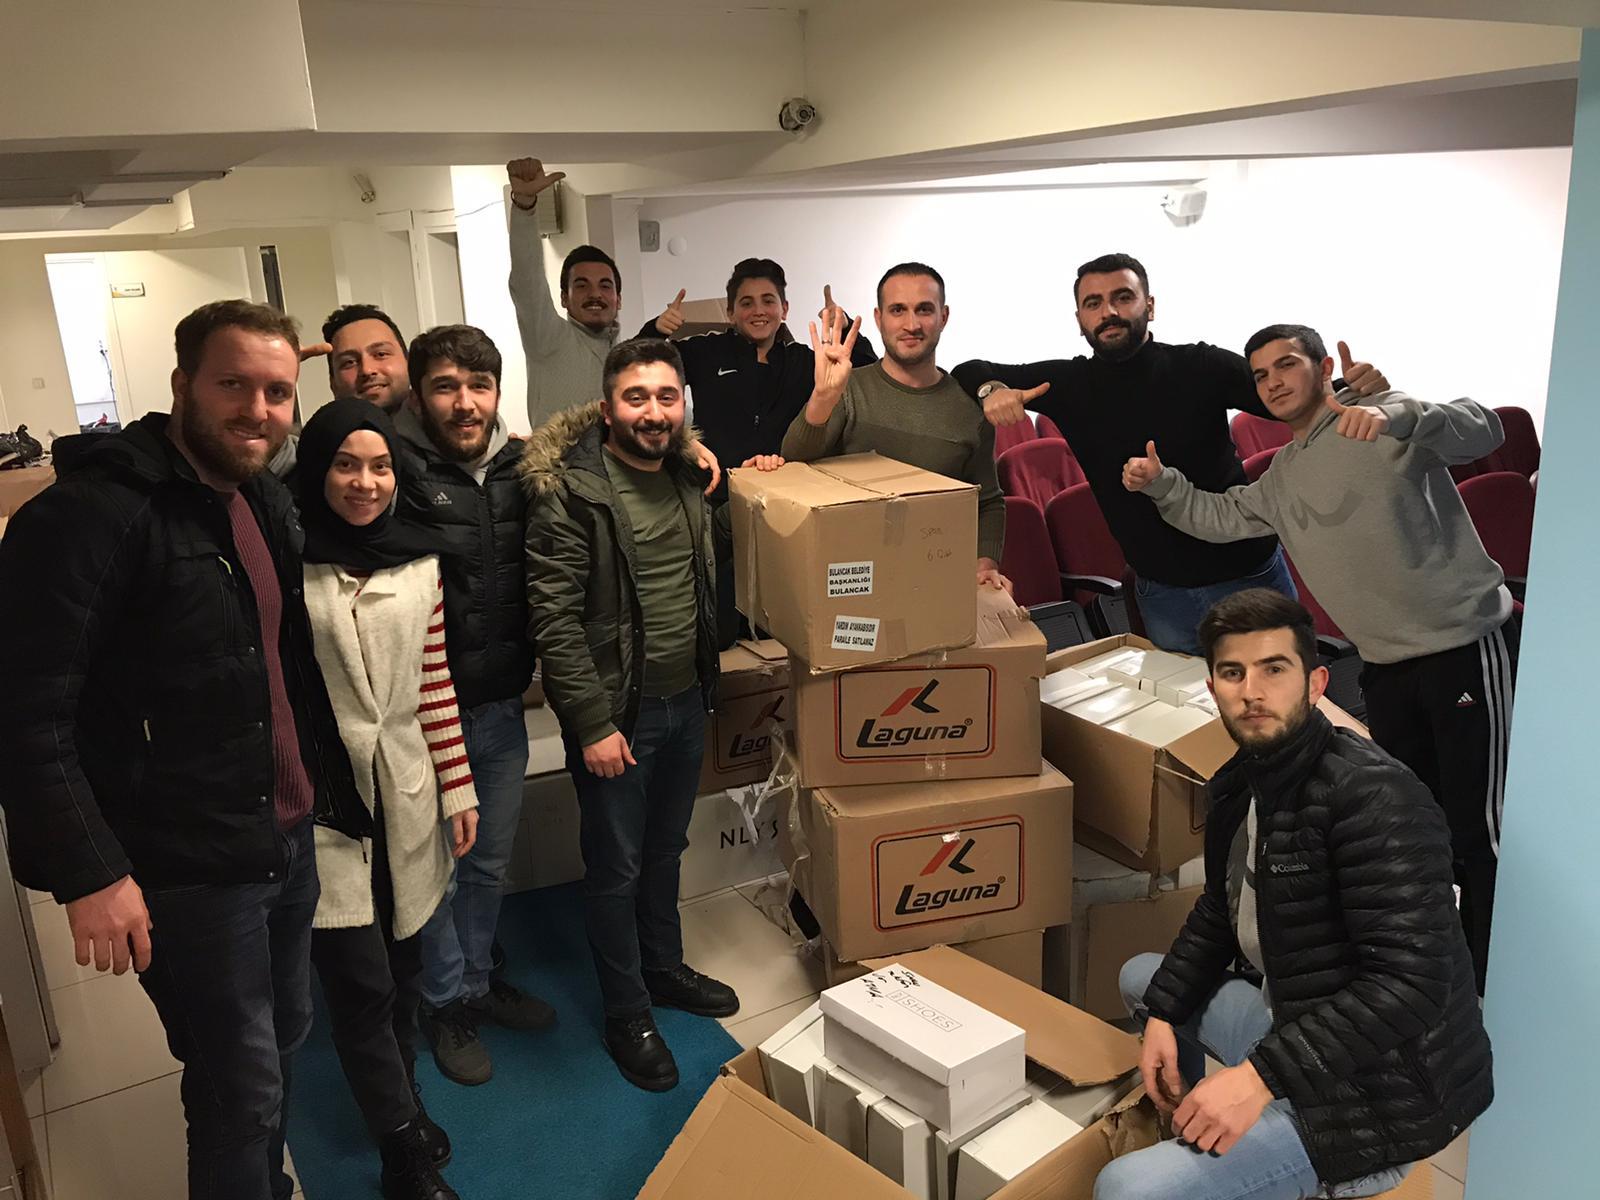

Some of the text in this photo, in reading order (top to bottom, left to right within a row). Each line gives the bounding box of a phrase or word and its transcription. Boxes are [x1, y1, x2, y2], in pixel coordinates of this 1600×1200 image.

[829, 567, 850, 577] BULANCAK
[829, 577, 871, 585] BAŞKANLIĞI
[829, 586, 870, 595] BULANCAK
[856, 718, 968, 748] Laguna
[895, 881, 1000, 916] Laguna
[902, 998, 954, 1028] SHOES
